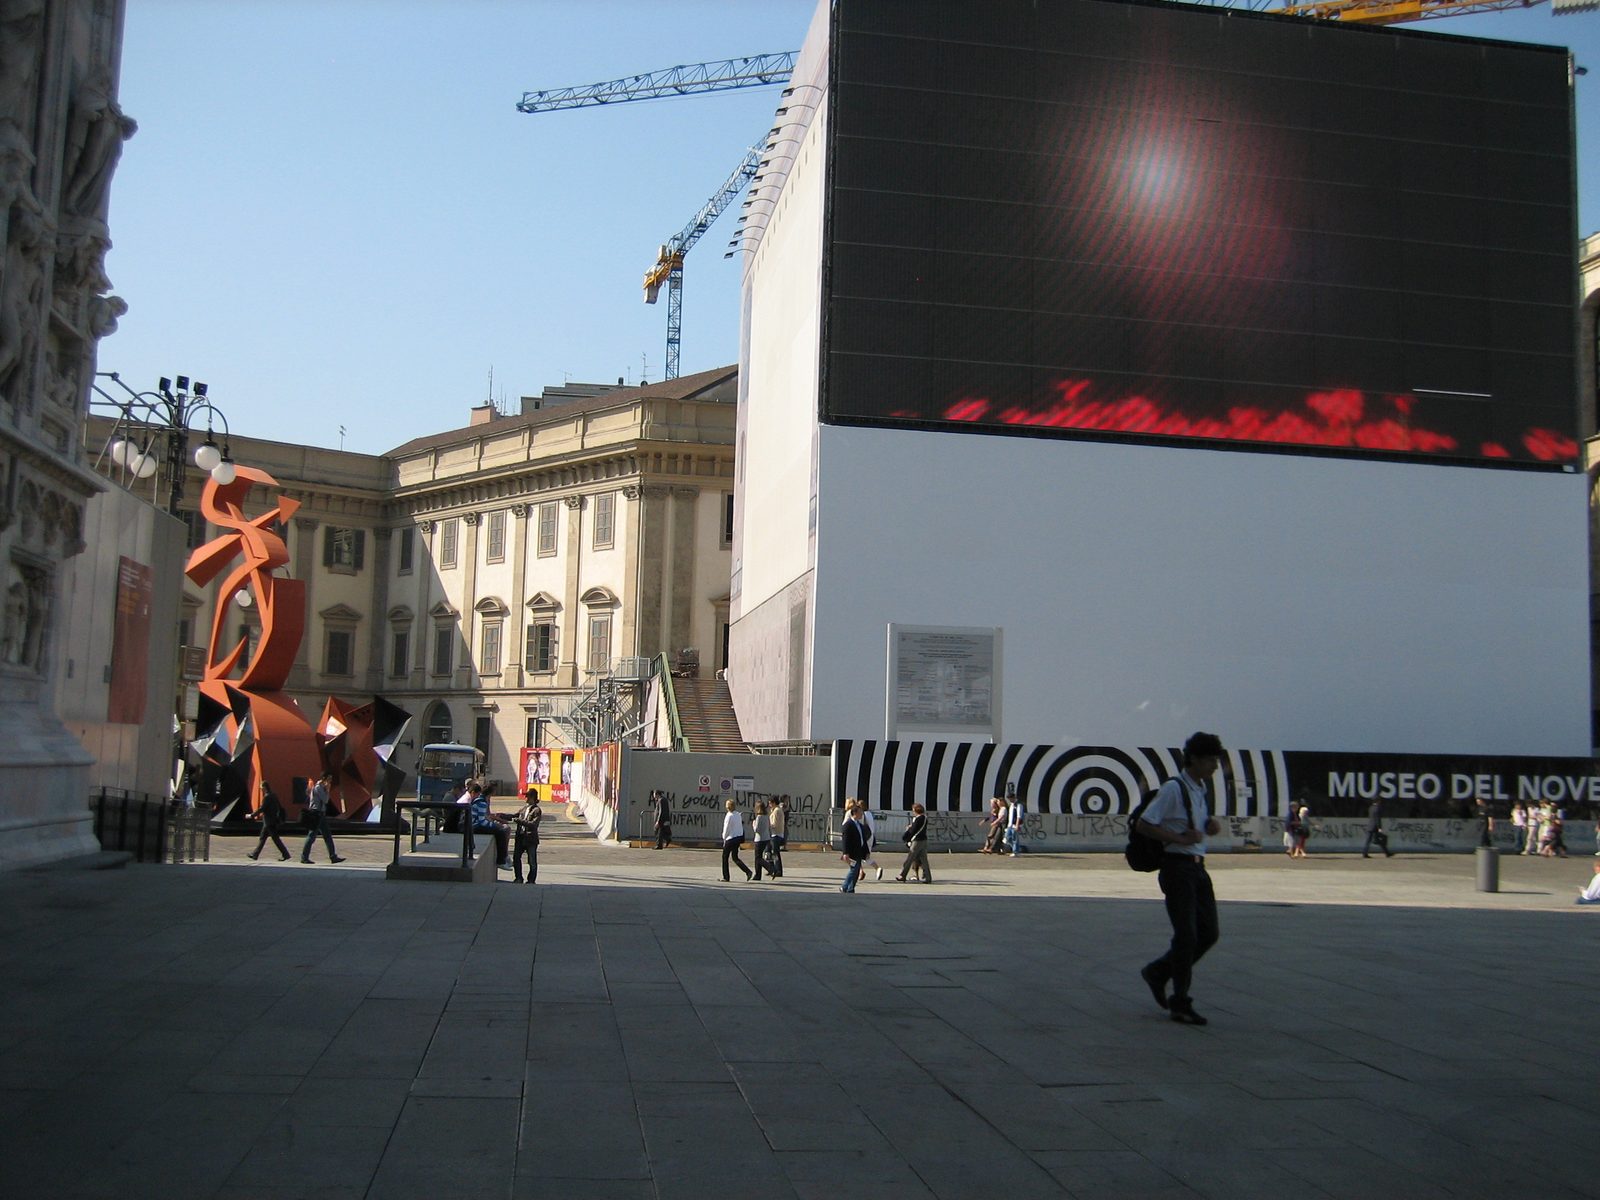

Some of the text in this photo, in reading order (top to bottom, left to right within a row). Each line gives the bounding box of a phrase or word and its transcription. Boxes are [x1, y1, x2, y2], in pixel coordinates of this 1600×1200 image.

[1329, 772, 1600, 801] MUSEO DEL NOVE
[682, 794, 720, 810] youth
[927, 824, 975, 842] ERDA
